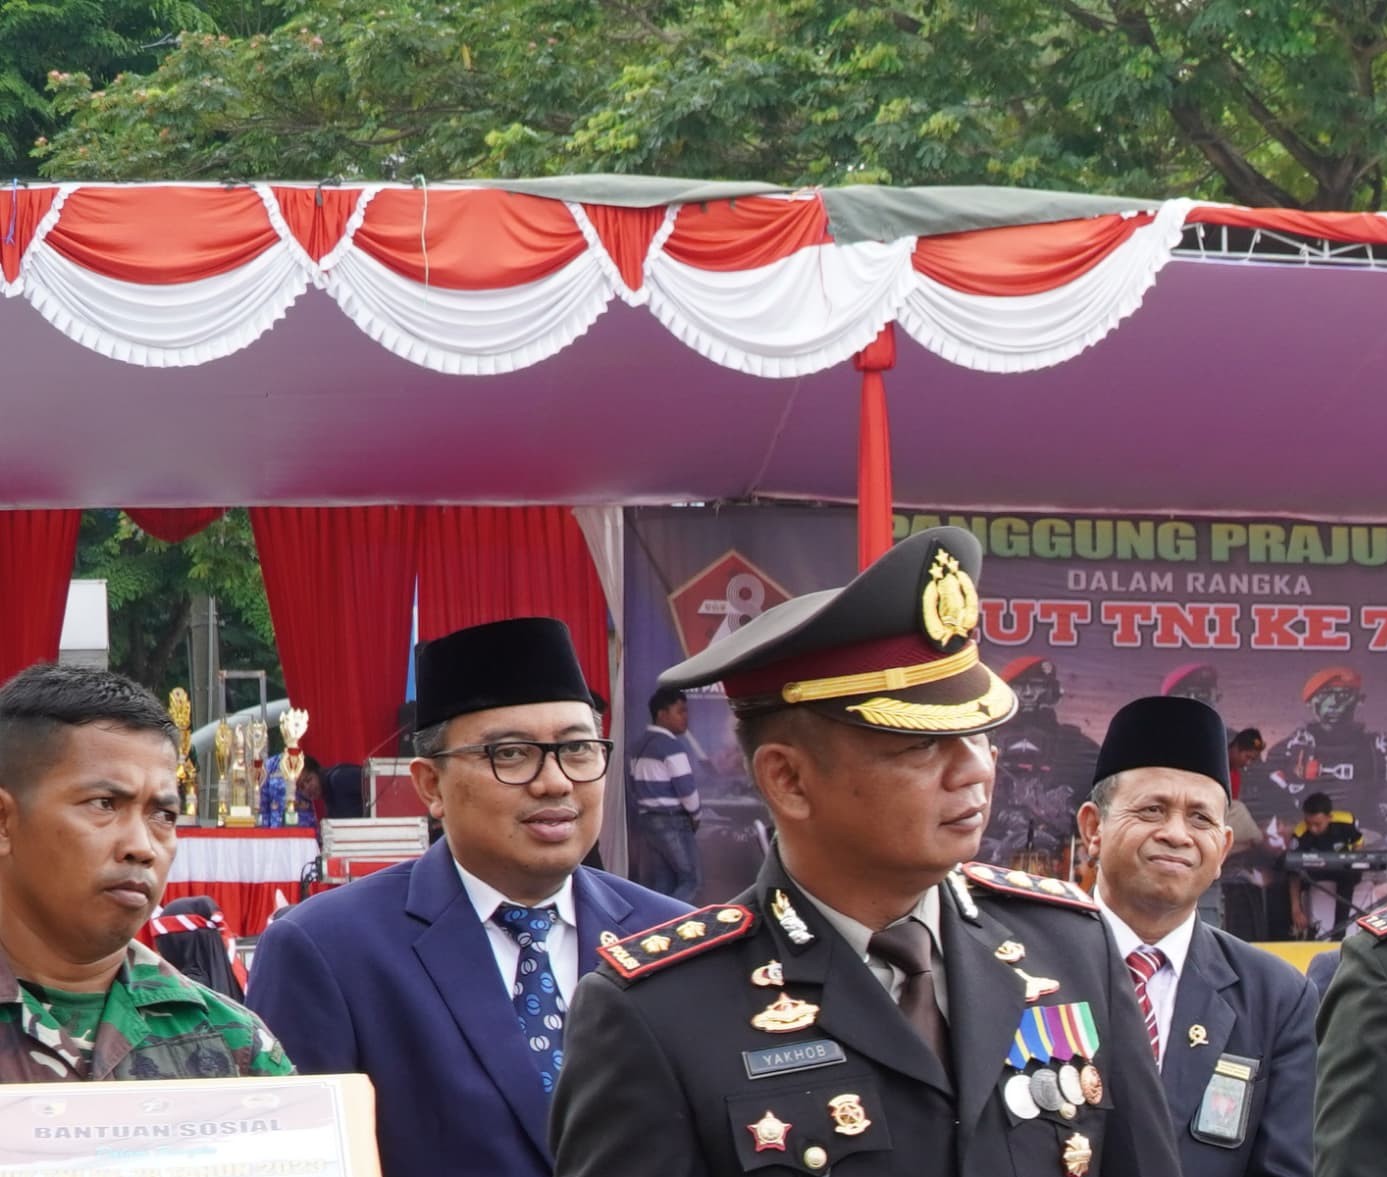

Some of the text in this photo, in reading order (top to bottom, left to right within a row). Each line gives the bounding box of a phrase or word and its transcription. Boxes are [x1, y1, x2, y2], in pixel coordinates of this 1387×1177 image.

[1067, 569, 1312, 596] DALAM RANGKA
[974, 598, 1091, 646] UT
[1101, 601, 1240, 650] TNI
[1251, 603, 1351, 652] KE
[762, 1044, 827, 1066] YAKHOB
[34, 1118, 283, 1140] BANTUAN SOSIAL
